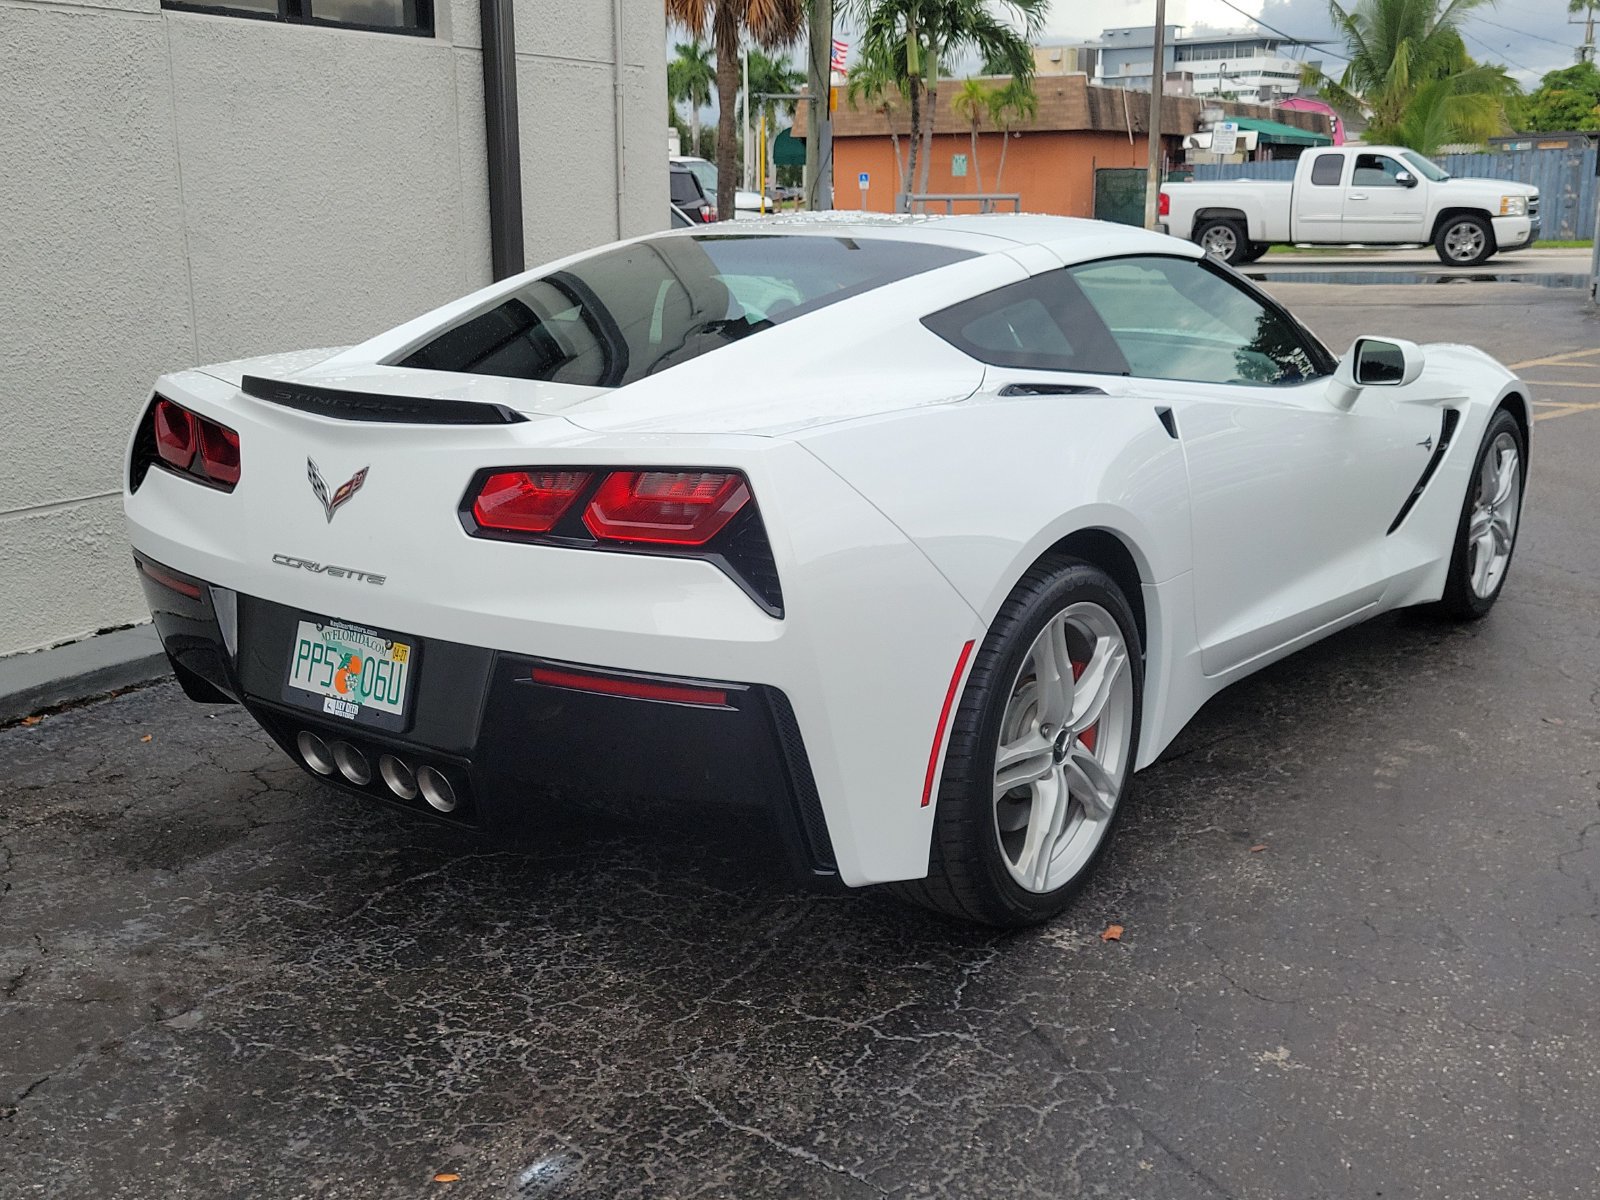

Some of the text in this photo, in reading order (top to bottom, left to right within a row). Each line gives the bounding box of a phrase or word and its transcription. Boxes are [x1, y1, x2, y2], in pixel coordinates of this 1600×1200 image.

[271, 554, 387, 585] CORVETTE
[295, 639, 403, 705] PP5 06U
